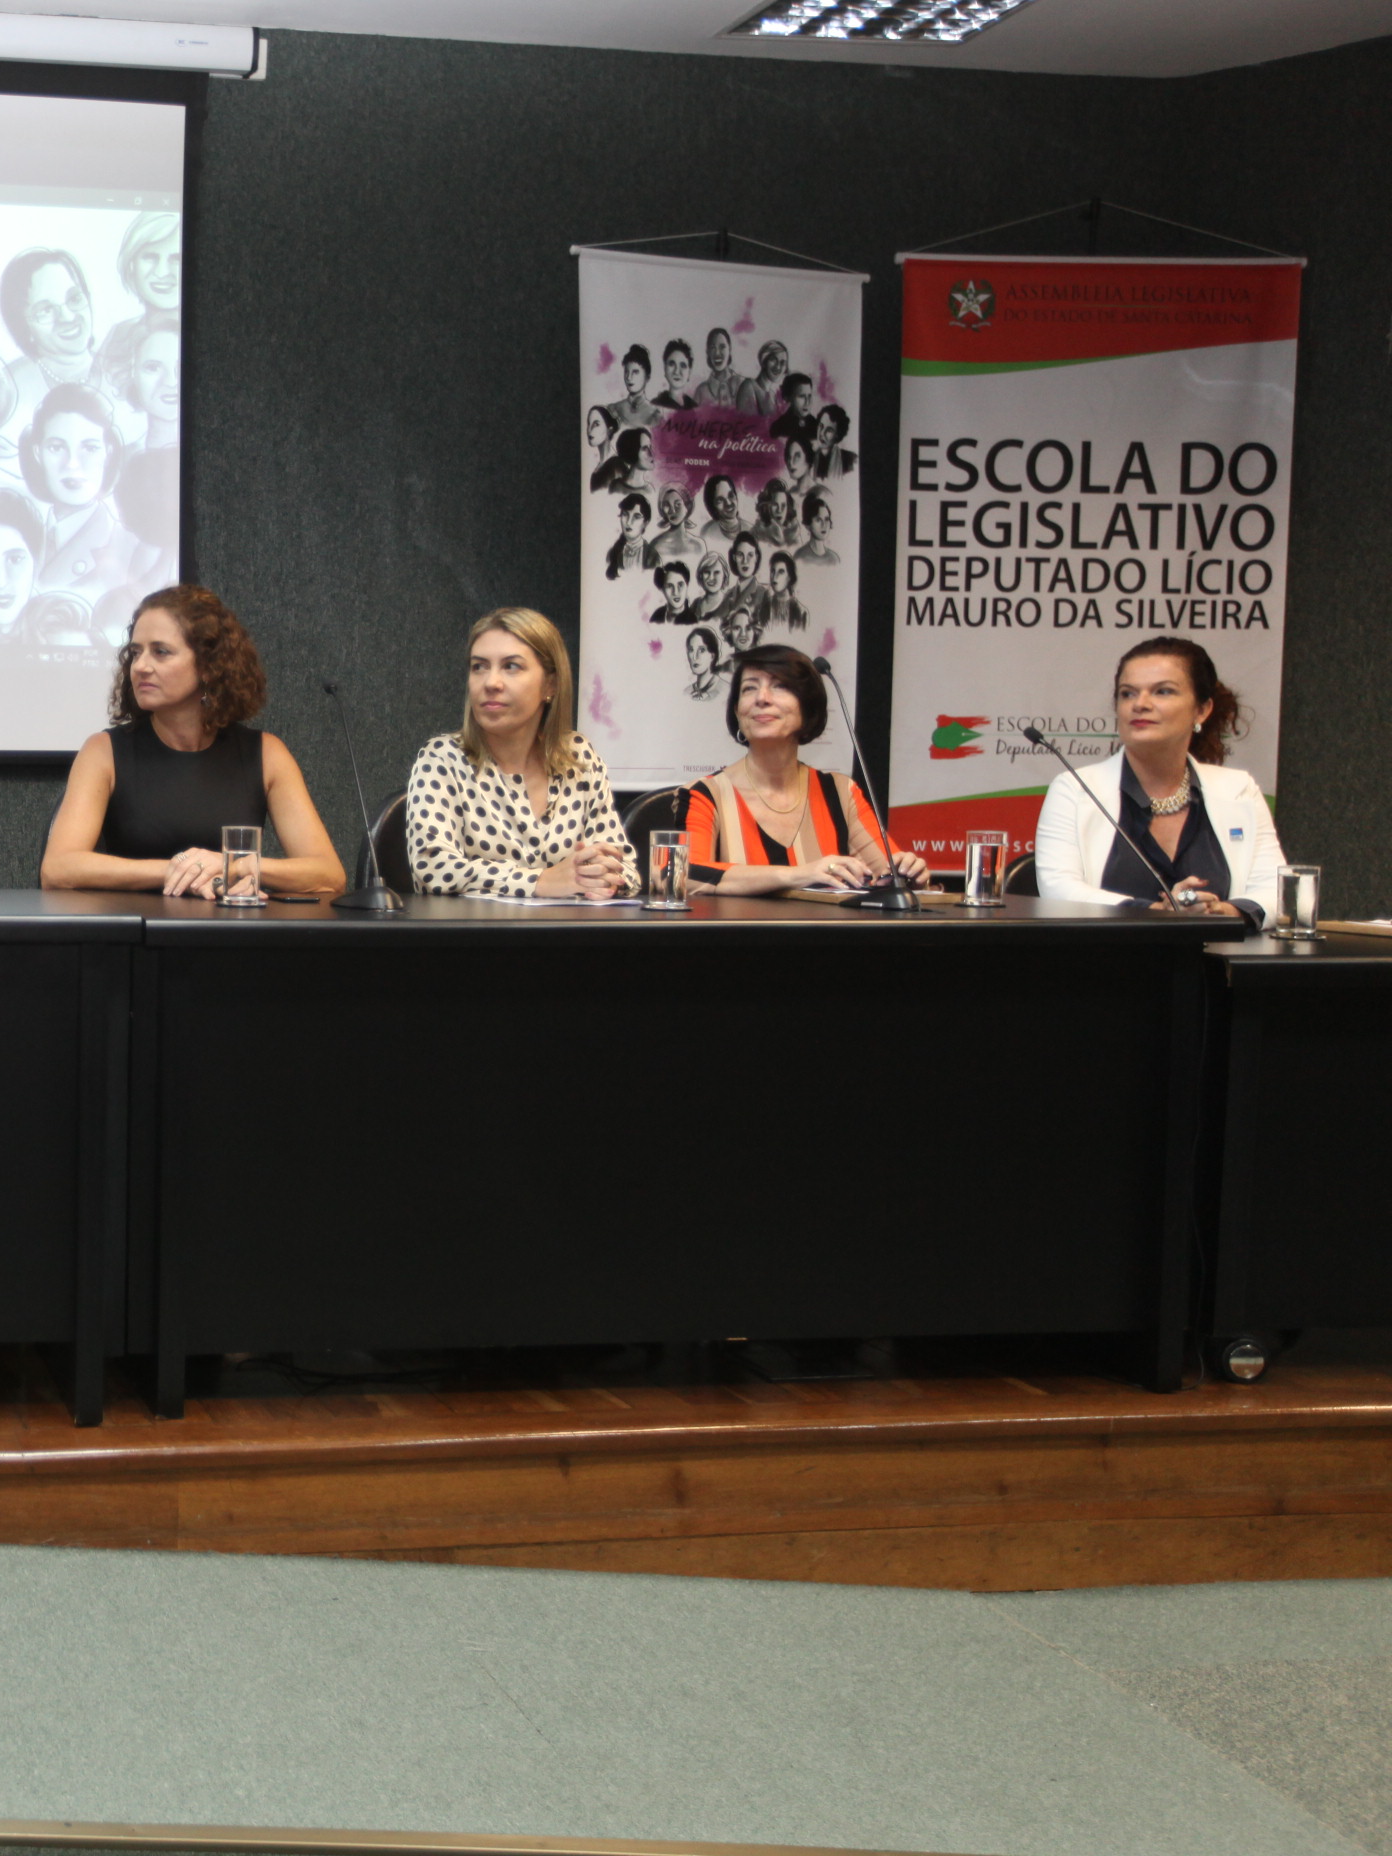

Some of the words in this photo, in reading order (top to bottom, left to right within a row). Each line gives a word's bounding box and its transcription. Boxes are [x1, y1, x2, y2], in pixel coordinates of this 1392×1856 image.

[1005, 284, 1123, 302] ASSEMBLEIA
[1131, 286, 1251, 304] LEGISLATIVA
[1003, 308, 1027, 322] DO
[1033, 309, 1092, 322] ESTADO
[1121, 309, 1170, 324] SANTA
[1175, 310, 1252, 325] CATARINA
[698, 438, 719, 450] na
[717, 432, 777, 459] política
[909, 438, 1157, 495] ESCOLA
[1180, 442, 1278, 497] DO
[908, 500, 1275, 552] LEGISLATIVO
[906, 555, 1146, 593] DEPUTADO
[1161, 551, 1273, 595] LÍCIO
[906, 597, 1042, 628] MAURO
[1053, 598, 1103, 629] DA
[1114, 598, 1270, 630] SILVEIRA
[996, 716, 1069, 733] ESCOLA
[1076, 717, 1106, 733] DO
[995, 739, 1061, 763] Deputado
[1067, 739, 1101, 756] Lício
